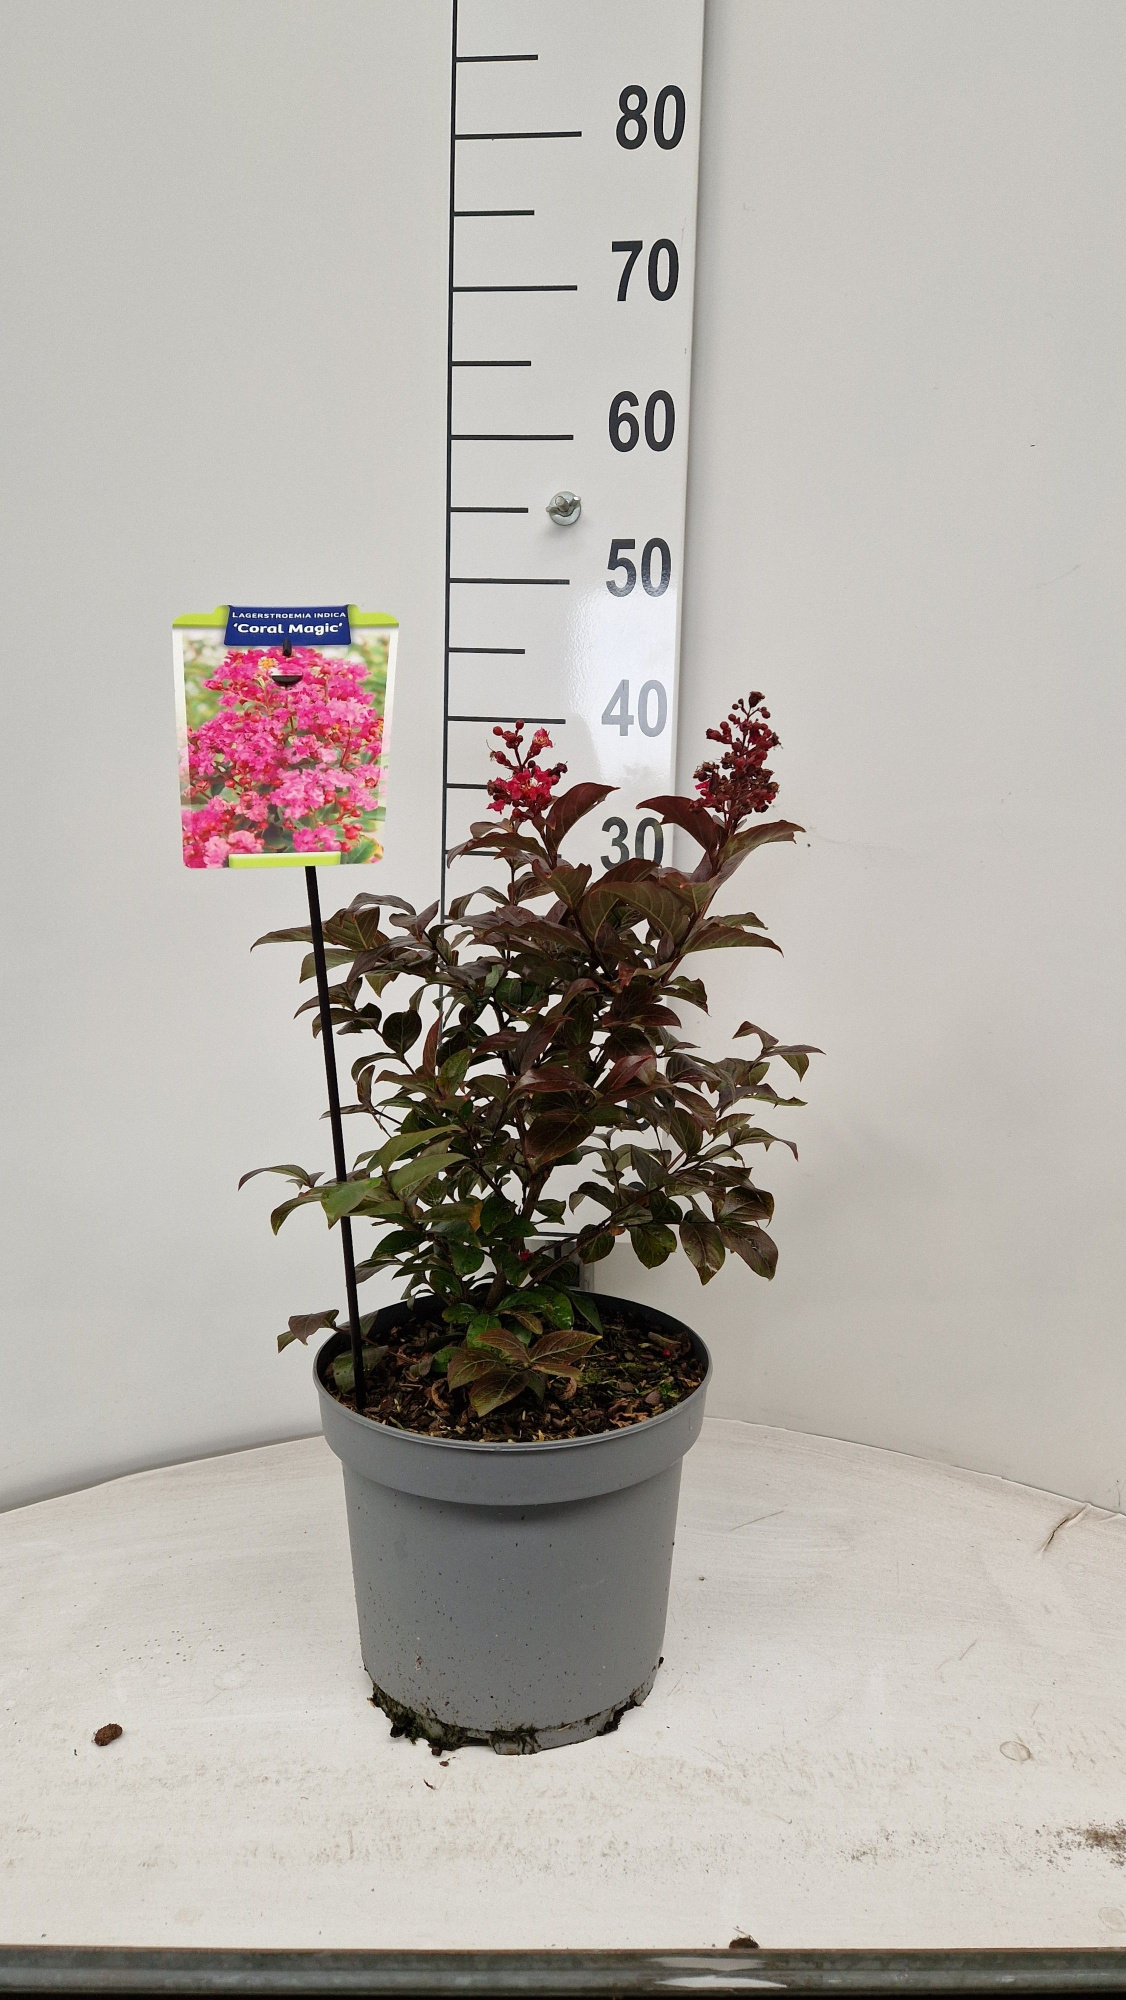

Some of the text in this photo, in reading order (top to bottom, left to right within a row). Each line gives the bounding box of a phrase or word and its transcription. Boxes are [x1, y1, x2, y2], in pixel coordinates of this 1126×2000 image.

[615, 84, 686, 150] 80
[611, 238, 679, 302] 70
[608, 389, 676, 453] 60
[606, 537, 672, 597] 50
[232, 611, 312, 619] LAGERSTROEMIA
[601, 679, 668, 737] 40
[600, 816, 665, 871] 30
